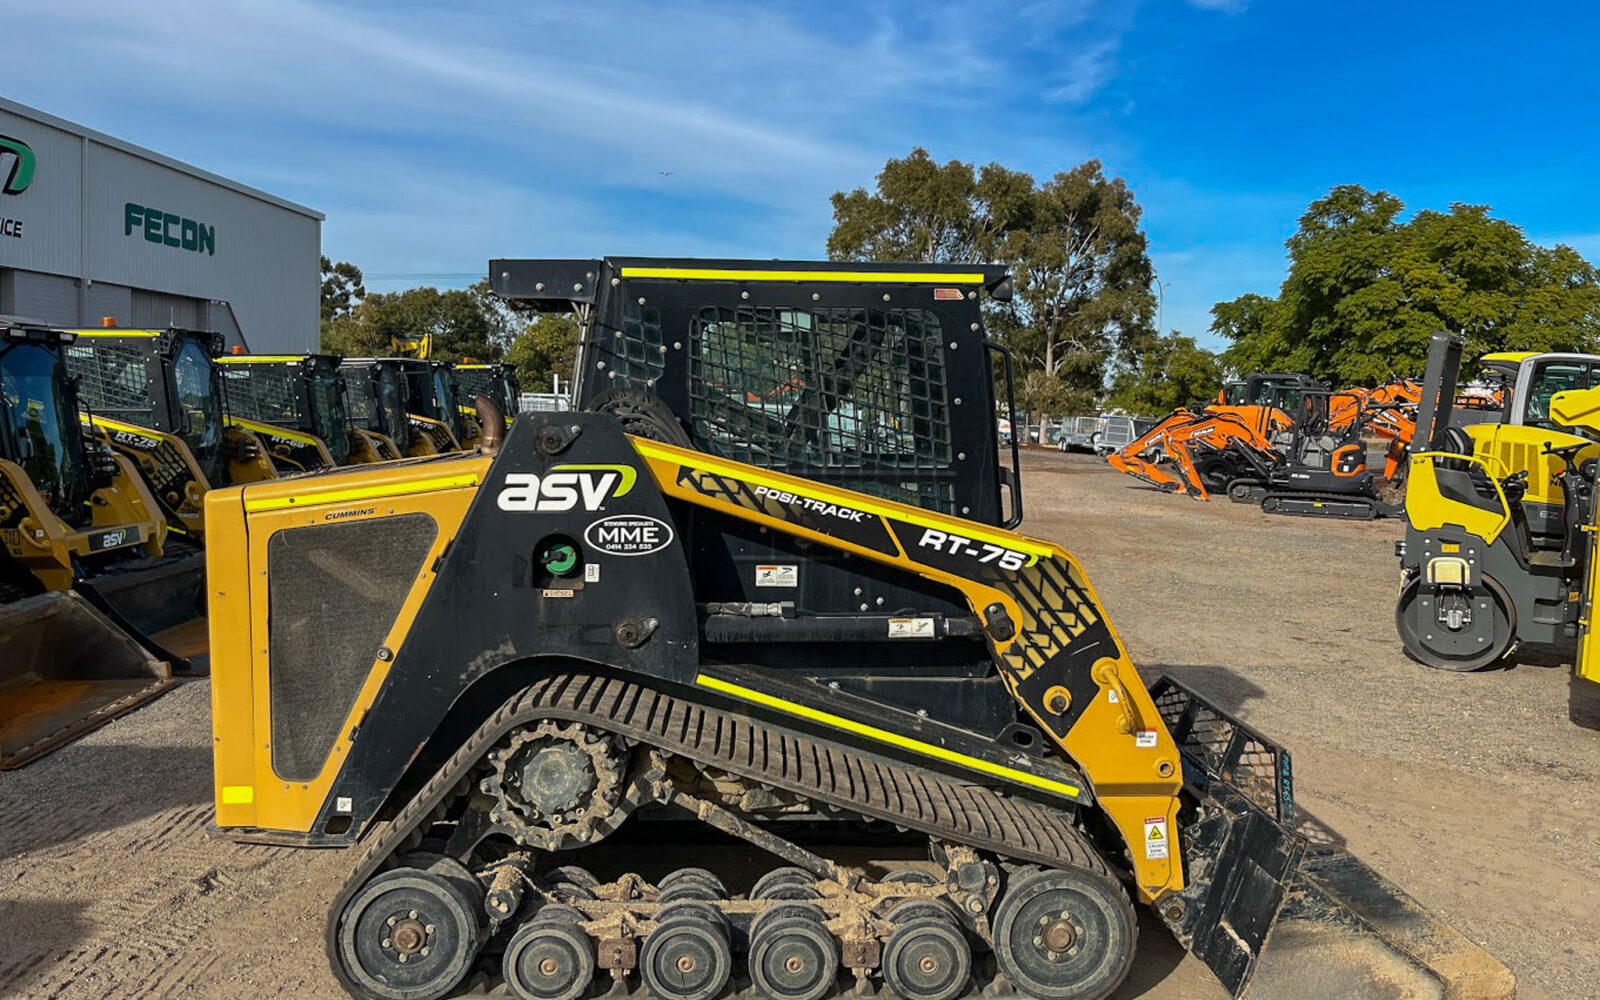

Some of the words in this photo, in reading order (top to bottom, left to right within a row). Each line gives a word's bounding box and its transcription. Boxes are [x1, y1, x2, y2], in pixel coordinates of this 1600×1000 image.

[124, 203, 215, 256] FECON
[325, 508, 375, 520] CUMMINS
[754, 486, 865, 523] POSI-TRACK
[598, 527, 660, 543] MME
[918, 529, 1026, 571] RT-75
